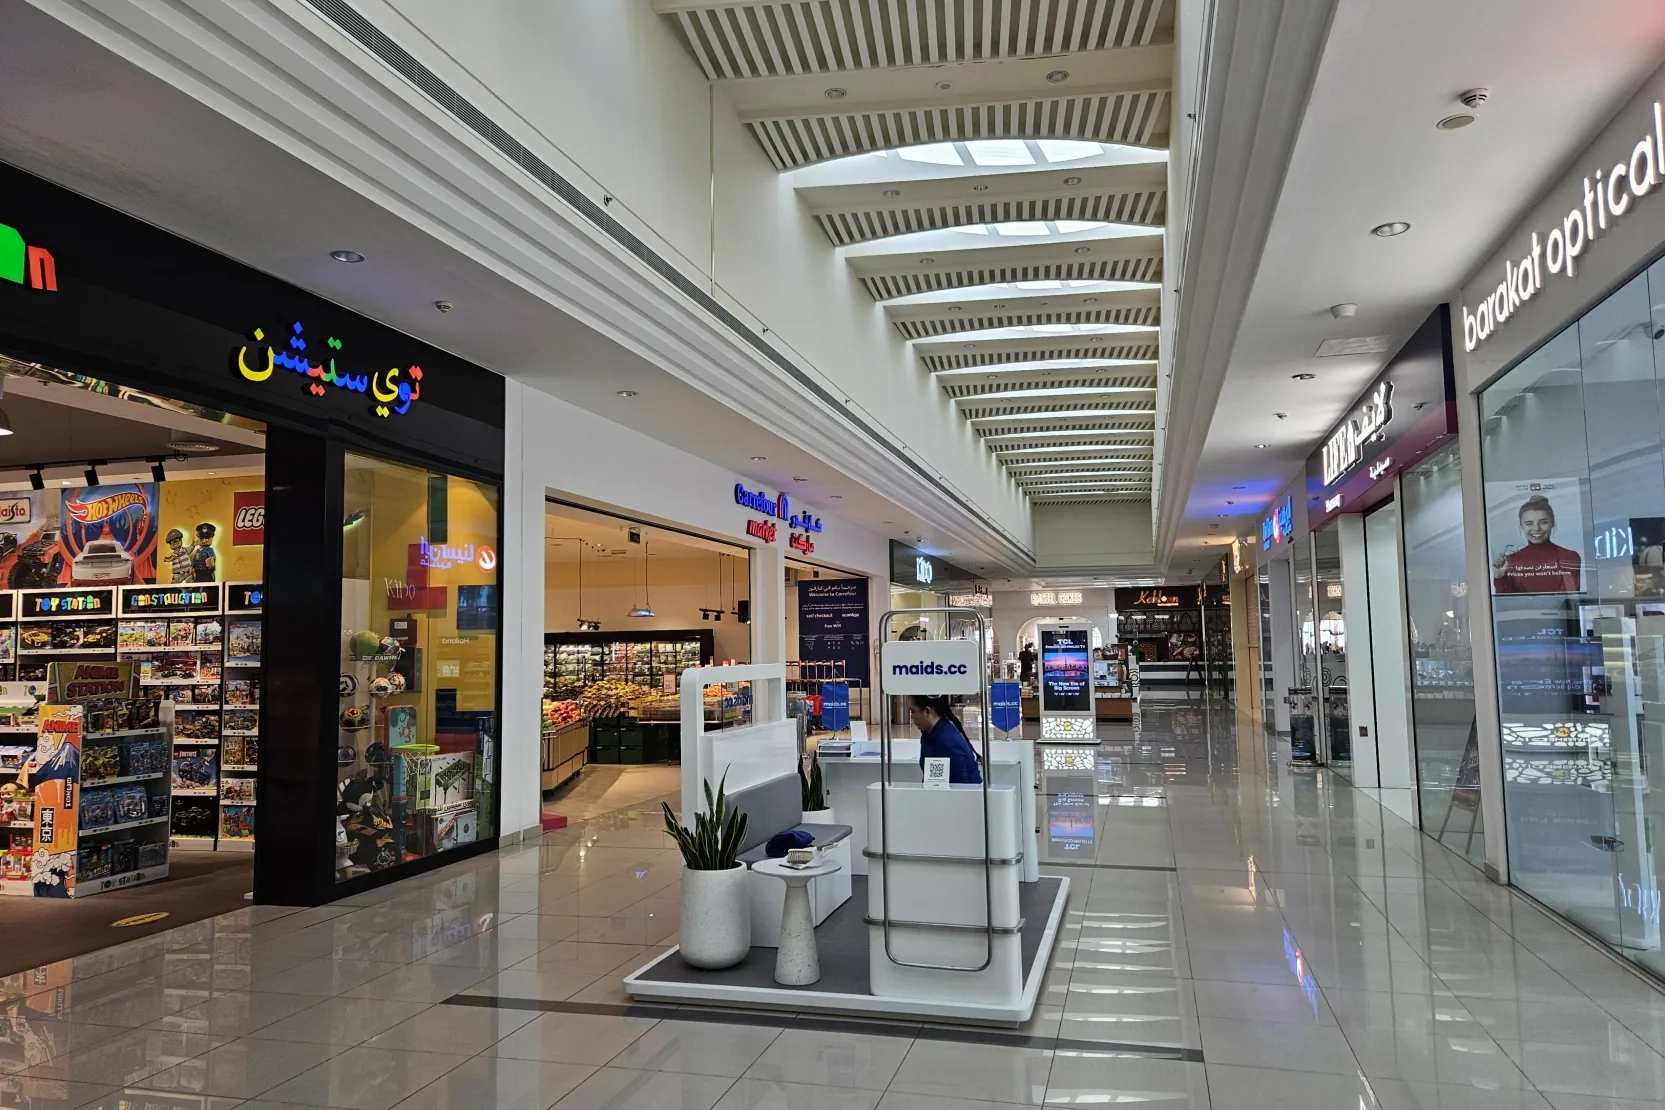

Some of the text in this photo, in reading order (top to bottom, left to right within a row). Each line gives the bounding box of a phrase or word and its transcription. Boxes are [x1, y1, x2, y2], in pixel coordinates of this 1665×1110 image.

[1462, 101, 1665, 352] barakat optical
[238, 321, 424, 418] توي ستيشن
[734, 482, 777, 517] Carrefour
[236, 507, 265, 529] LEG
[746, 519, 777, 544] market
[35, 597, 60, 612] TOY
[73, 664, 121, 680] ANIME
[892, 661, 967, 675] maids.cc
[65, 681, 125, 699] STATION
[42, 719, 81, 733] ANIME
[41, 808, 53, 842] 東京
